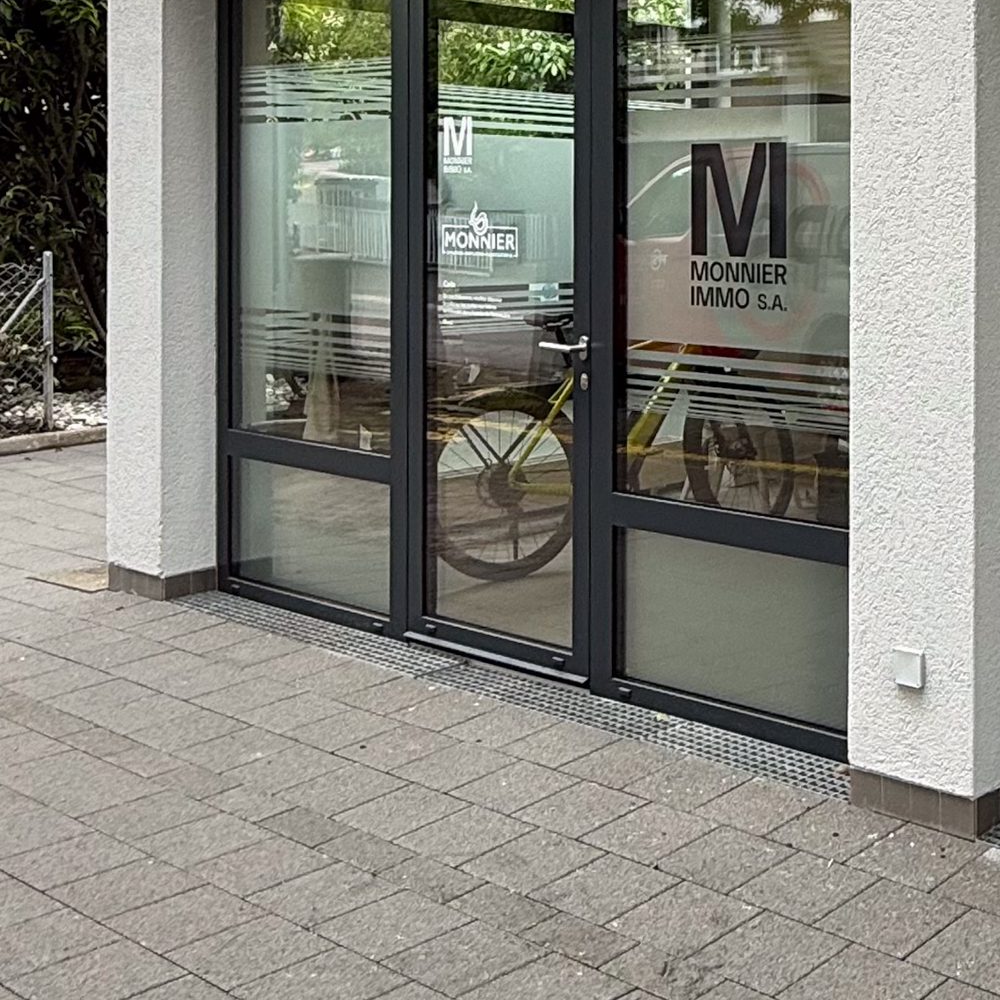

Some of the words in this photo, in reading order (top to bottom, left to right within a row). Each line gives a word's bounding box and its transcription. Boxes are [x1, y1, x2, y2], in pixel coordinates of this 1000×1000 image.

[444, 231, 516, 250] MONNIER
[690, 261, 788, 285] MONNIER
[690, 285, 750, 310] IMMO
[757, 293, 788, 312] S.A.
